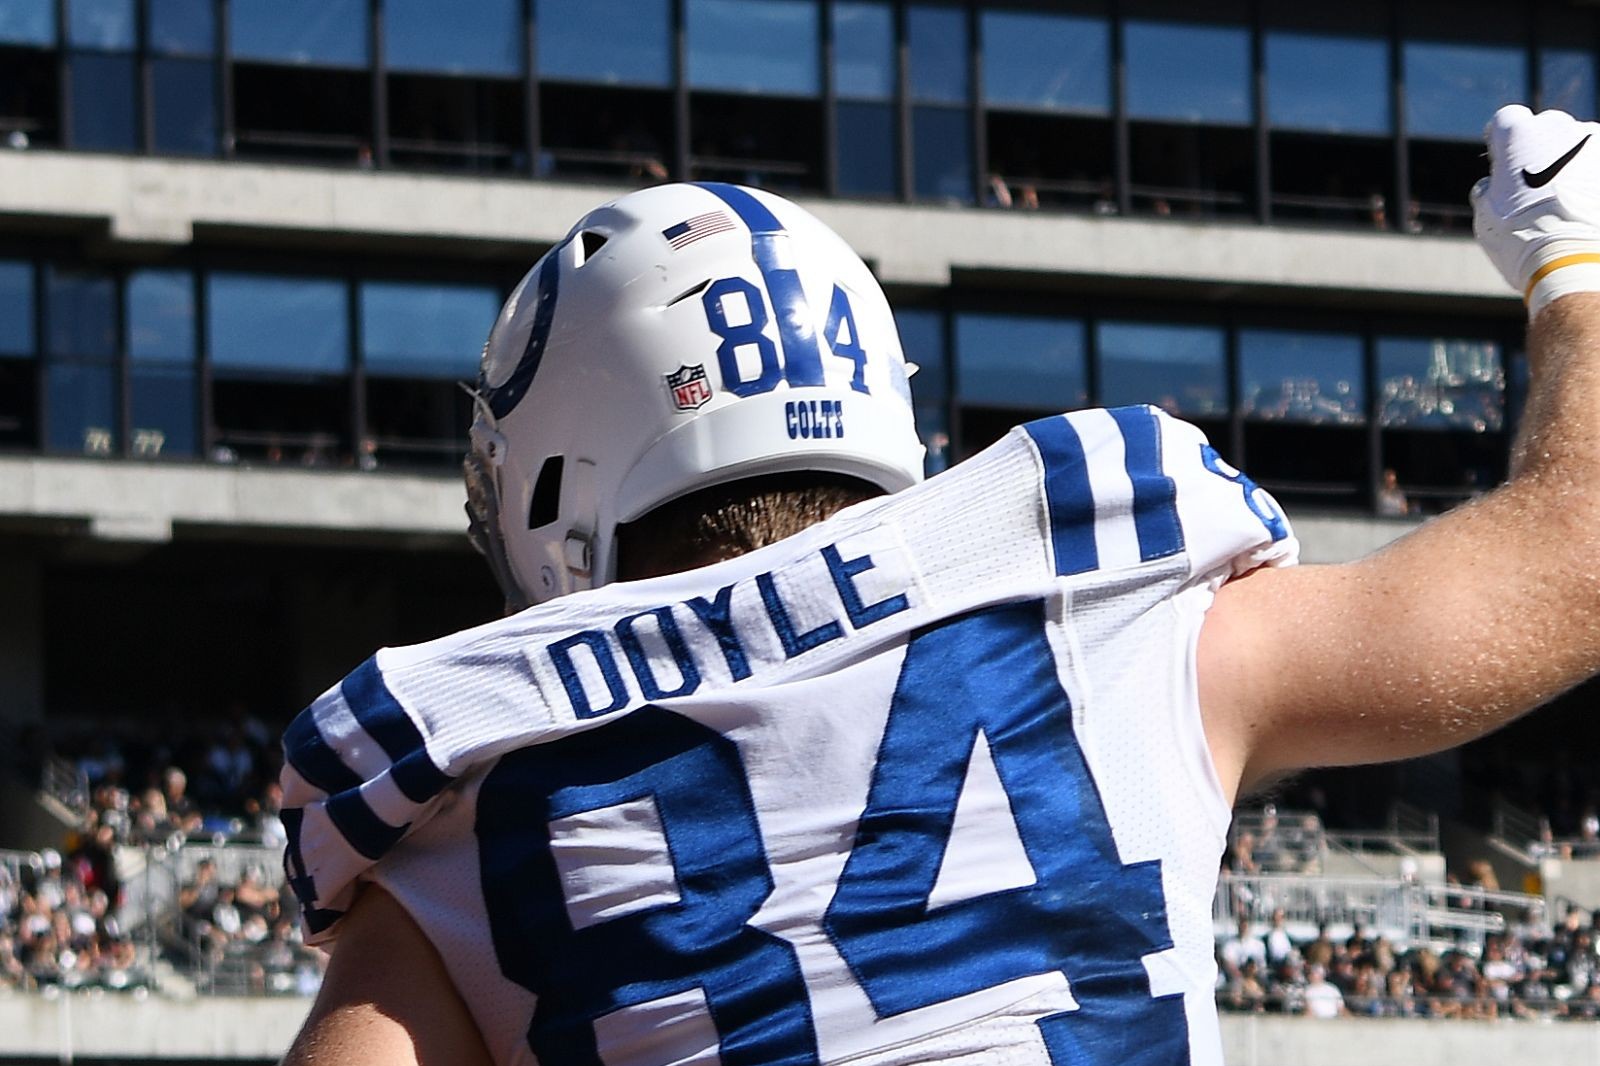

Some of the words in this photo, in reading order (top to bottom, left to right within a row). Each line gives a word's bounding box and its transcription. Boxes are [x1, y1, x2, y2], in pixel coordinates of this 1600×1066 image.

[702, 276, 870, 397] 84
[674, 381, 711, 406] NFL
[785, 400, 844, 439] COLTS
[547, 543, 909, 720] DOYLE
